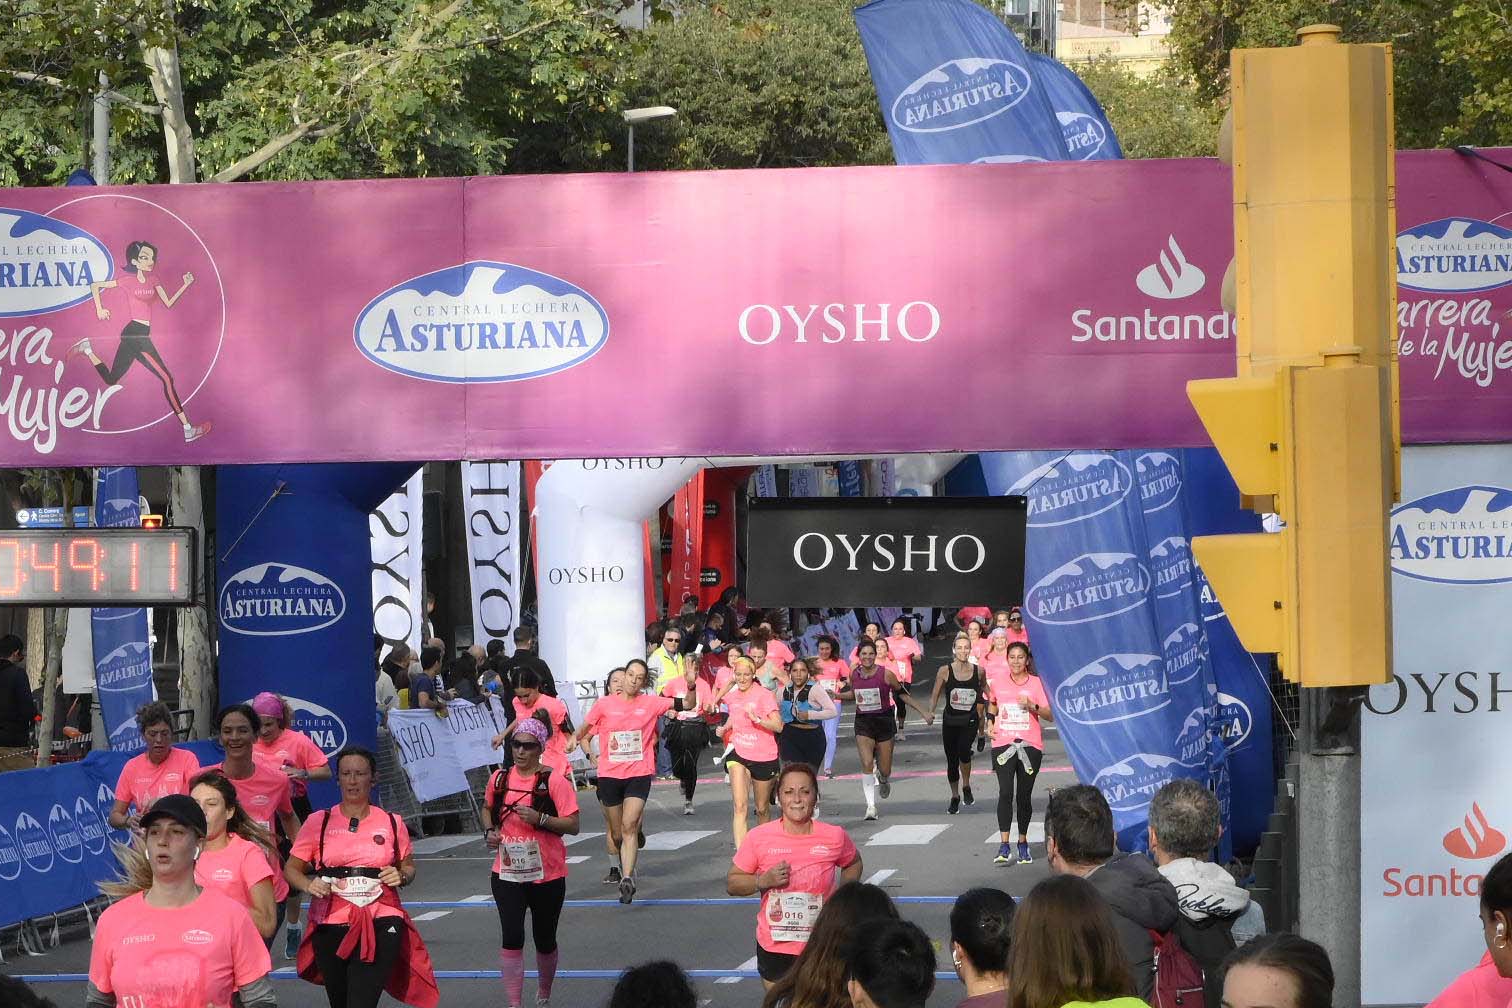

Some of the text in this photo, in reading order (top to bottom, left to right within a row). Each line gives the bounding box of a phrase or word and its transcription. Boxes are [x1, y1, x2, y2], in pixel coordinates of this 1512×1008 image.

[17, 244, 89, 256] LECHERA
[414, 301, 581, 316] CENTRAL LECHERA
[1397, 298, 1492, 327] arrera
[374, 308, 589, 353] ASTURIANA
[738, 301, 941, 345] OYSHO
[1071, 309, 1237, 343] Santand
[1420, 328, 1438, 356] la
[1418, 520, 1479, 531] CENTRAL
[793, 533, 986, 573] OYSHO
[549, 565, 624, 585] OYSHO
[283, 587, 332, 596] LECHERA
[223, 591, 337, 620] ASTURIANA
[289, 719, 333, 727] ECHERA
[349, 877, 368, 886] 016
[784, 911, 804, 920] 016
